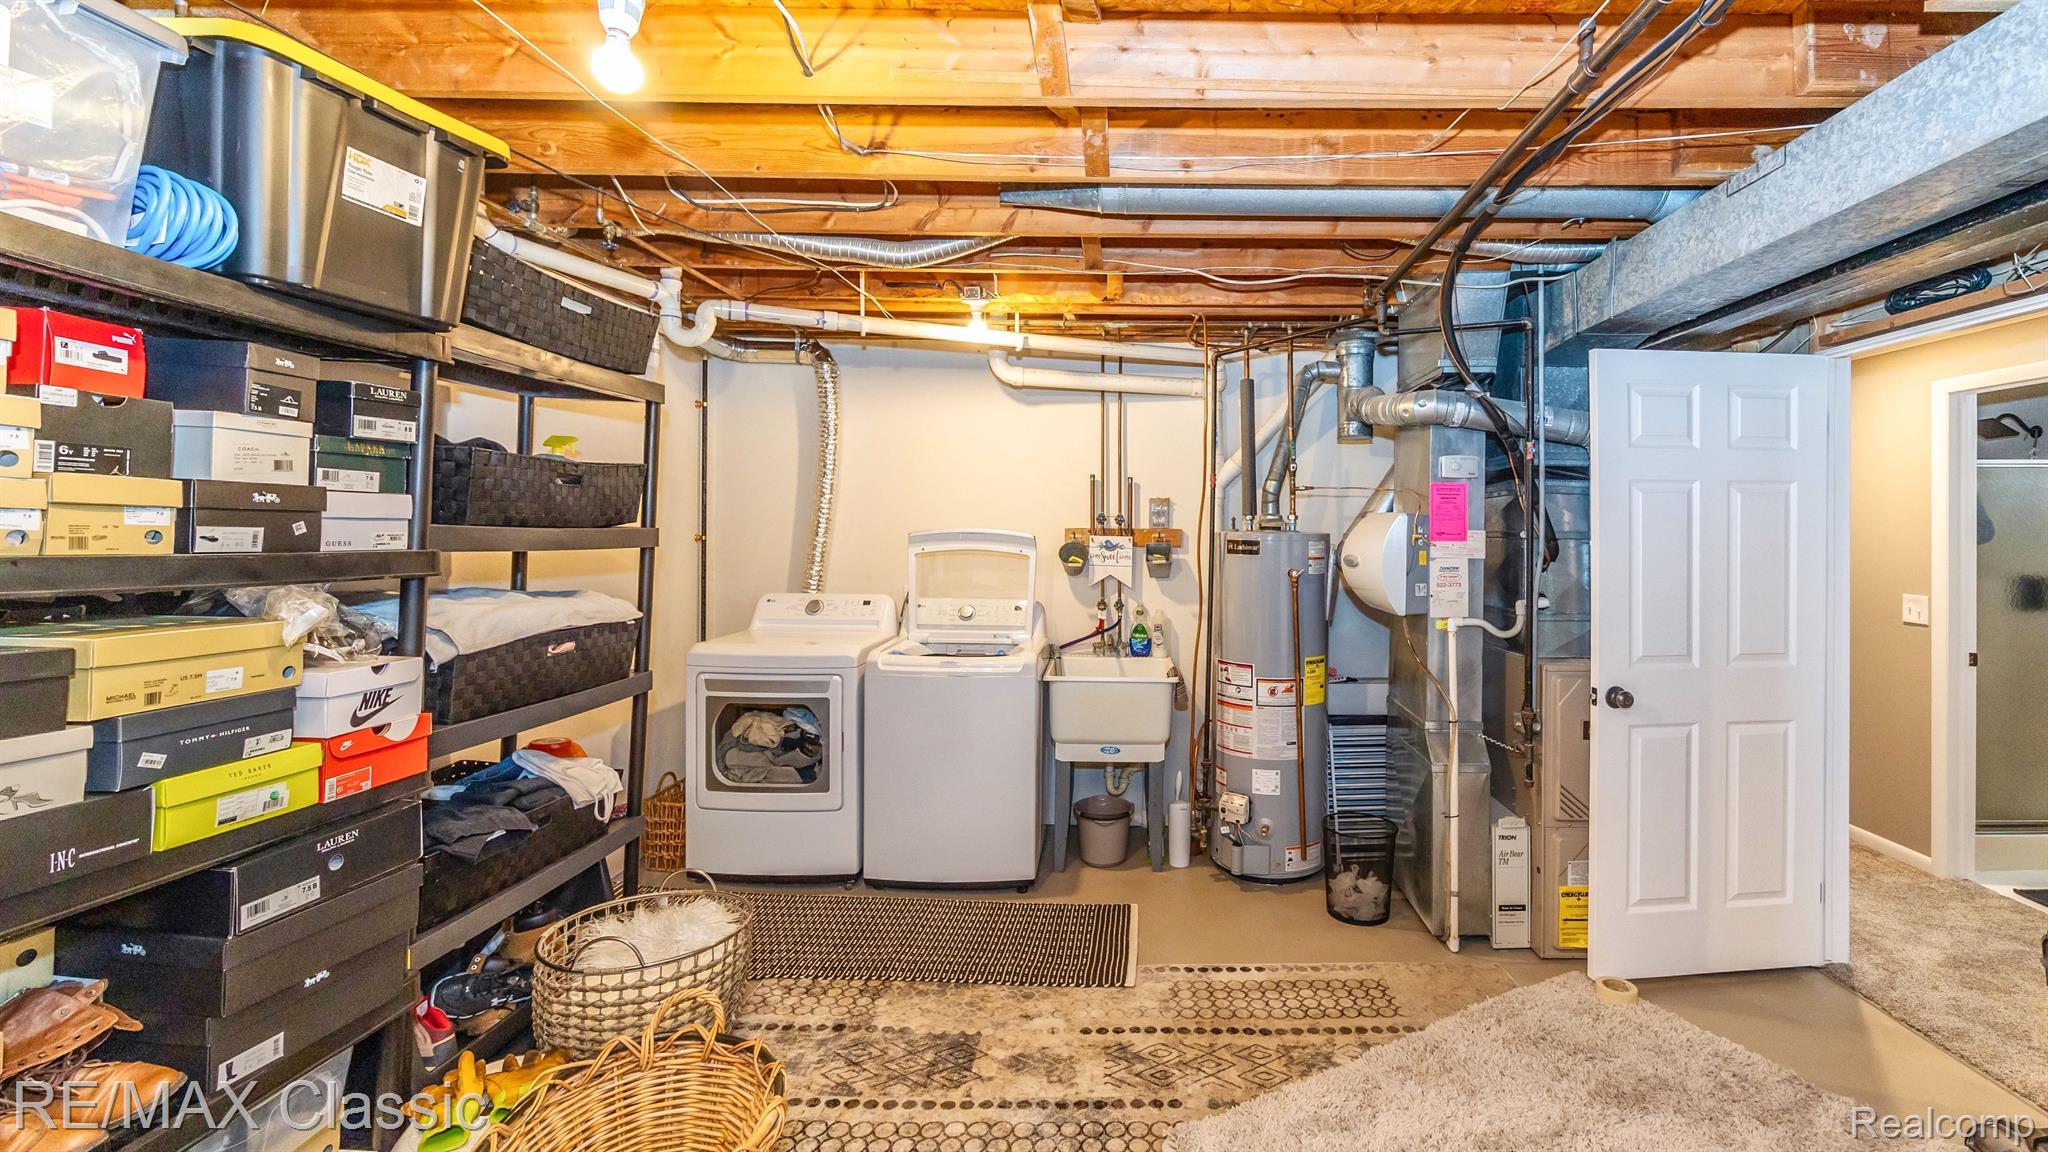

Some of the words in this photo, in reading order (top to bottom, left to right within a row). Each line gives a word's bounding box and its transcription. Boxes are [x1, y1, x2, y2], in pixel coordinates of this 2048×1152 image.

[111, 334, 136, 345] PUMA
[370, 387, 407, 399] LAUREN
[105, 692, 137, 702] MICHAEL
[358, 687, 394, 712] NIKE
[179, 735, 210, 746] TOMMY
[219, 726, 250, 736] HILFIGER
[248, 763, 272, 774] BAKER
[317, 829, 360, 852] LAUREN
[1498, 850, 1509, 858] Air
[1509, 850, 1524, 858] Bear
[302, 884, 311, 893] 7.5
